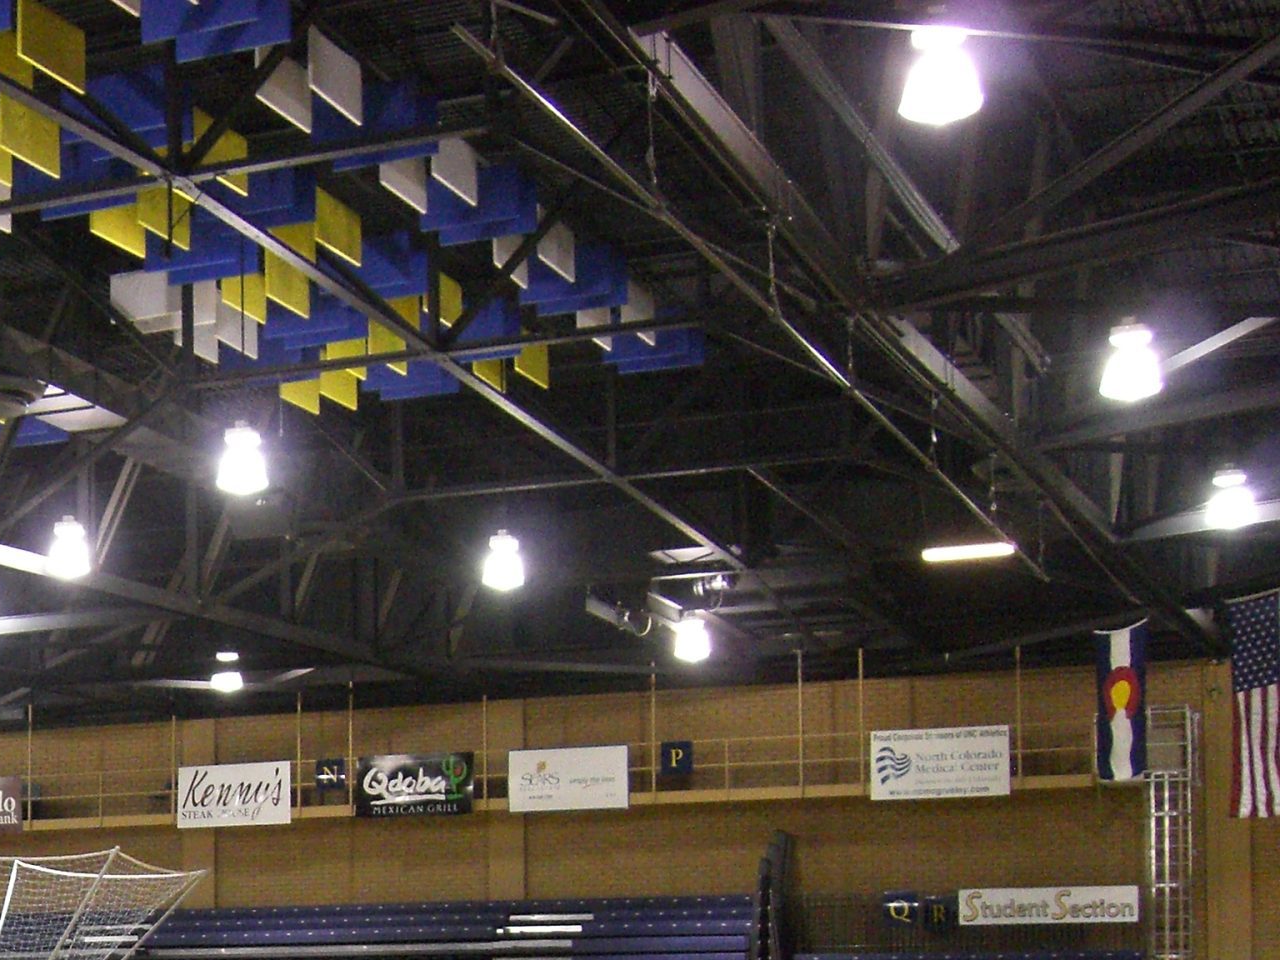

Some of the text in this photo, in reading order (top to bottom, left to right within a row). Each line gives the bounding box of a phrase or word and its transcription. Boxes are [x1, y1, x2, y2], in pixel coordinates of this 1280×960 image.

[671, 749, 683, 767] P
[915, 749, 1003, 762] North Colorado
[323, 765, 338, 783] N
[915, 762, 1000, 773] Medical Center
[363, 767, 446, 799] Qdoba
[183, 767, 282, 820] Kenny's
[181, 809, 213, 819] STEAK
[372, 803, 458, 815] MEXICAN GRILL
[889, 899, 911, 922] Q
[932, 904, 945, 921] R
[963, 890, 1135, 922] Student Section
